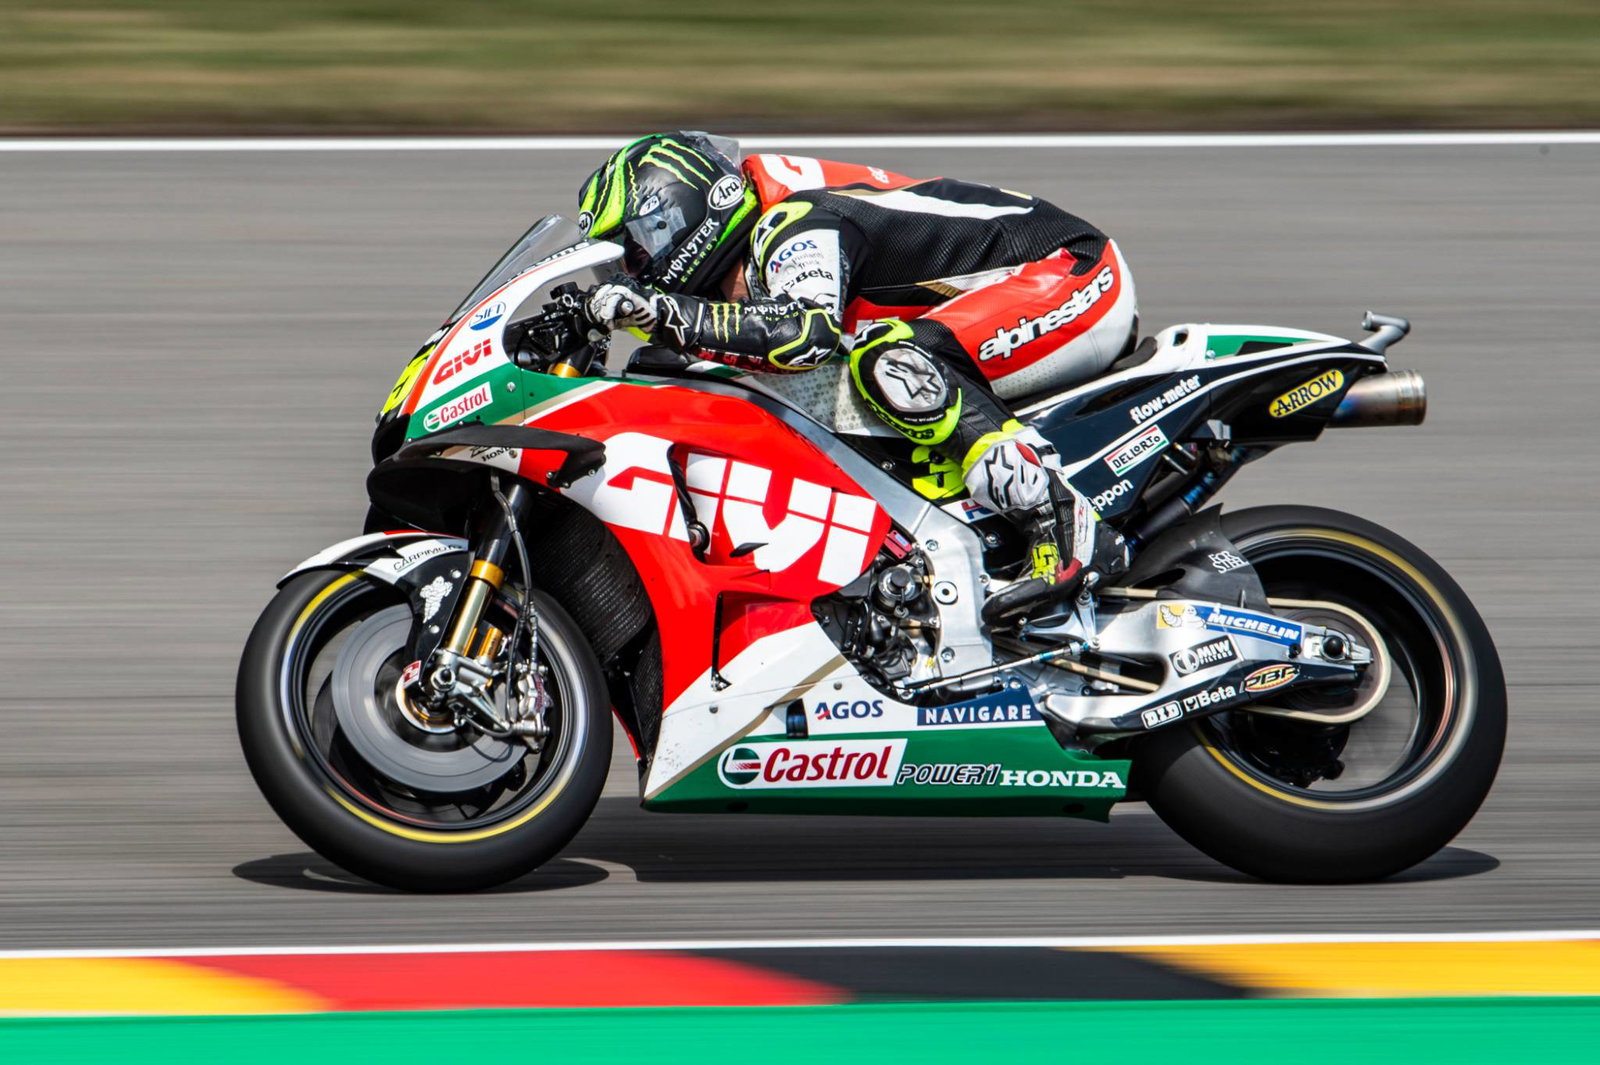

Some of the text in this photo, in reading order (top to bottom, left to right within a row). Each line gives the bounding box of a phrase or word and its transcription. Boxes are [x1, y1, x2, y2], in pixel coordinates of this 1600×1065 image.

[662, 218, 720, 284] MONSTER
[680, 235, 718, 283] ENERGY
[769, 239, 818, 274] AGOS
[795, 268, 834, 284] Beta
[978, 264, 1115, 362] alpinestars
[432, 338, 493, 385] GIVI
[440, 387, 489, 424] Castrol
[1129, 374, 1201, 425] flow-meter
[1273, 370, 1337, 416] ARROW
[560, 431, 878, 588] GIVI
[1206, 611, 1300, 641] MICHELIN
[1196, 639, 1231, 659] MIW
[815, 699, 884, 720] AGOS
[924, 703, 1032, 725] NAVIGARE
[1198, 685, 1236, 707] Beta
[763, 743, 892, 783] Castrol
[897, 762, 1127, 788] POWER1 HONDA
